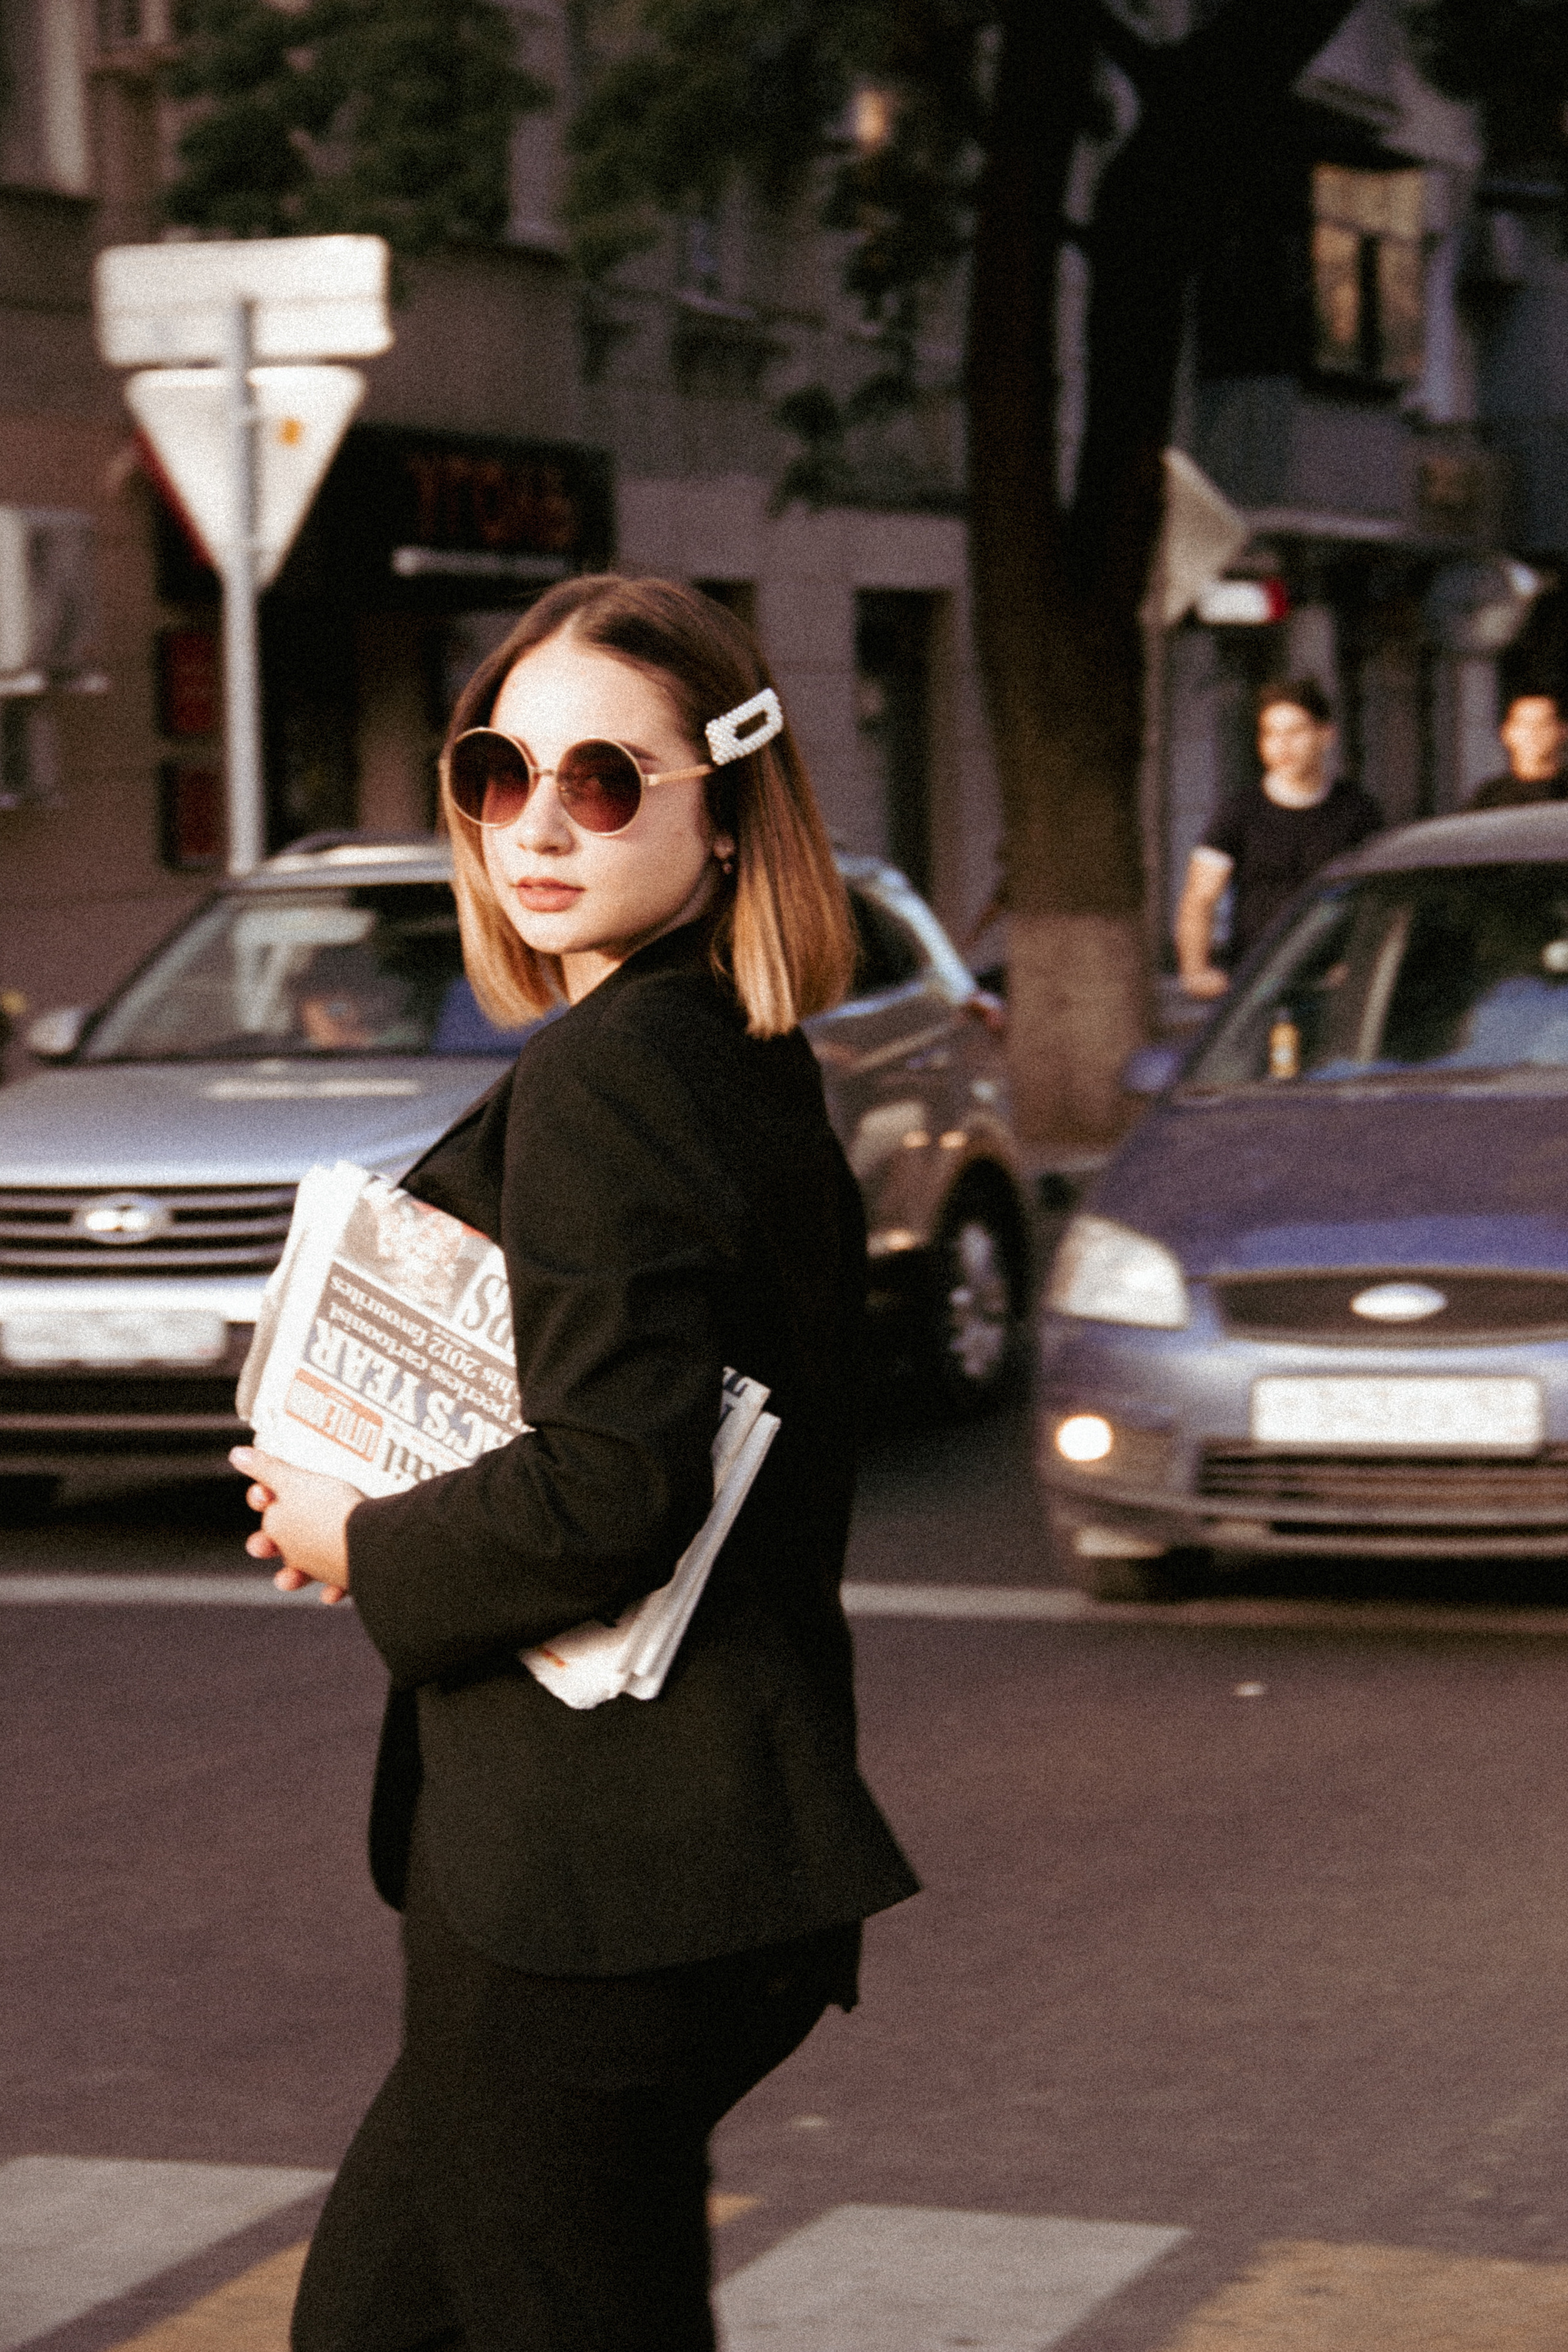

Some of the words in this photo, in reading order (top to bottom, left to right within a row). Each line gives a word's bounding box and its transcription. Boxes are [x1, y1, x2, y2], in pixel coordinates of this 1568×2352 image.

[330, 1302, 428, 1370] cartoonist
[331, 1276, 427, 1346] favourites
[310, 1318, 420, 1424] YEAR
[428, 1336, 482, 1378] 2012
[482, 1367, 516, 1399] his
[430, 1365, 512, 1421] peerless
